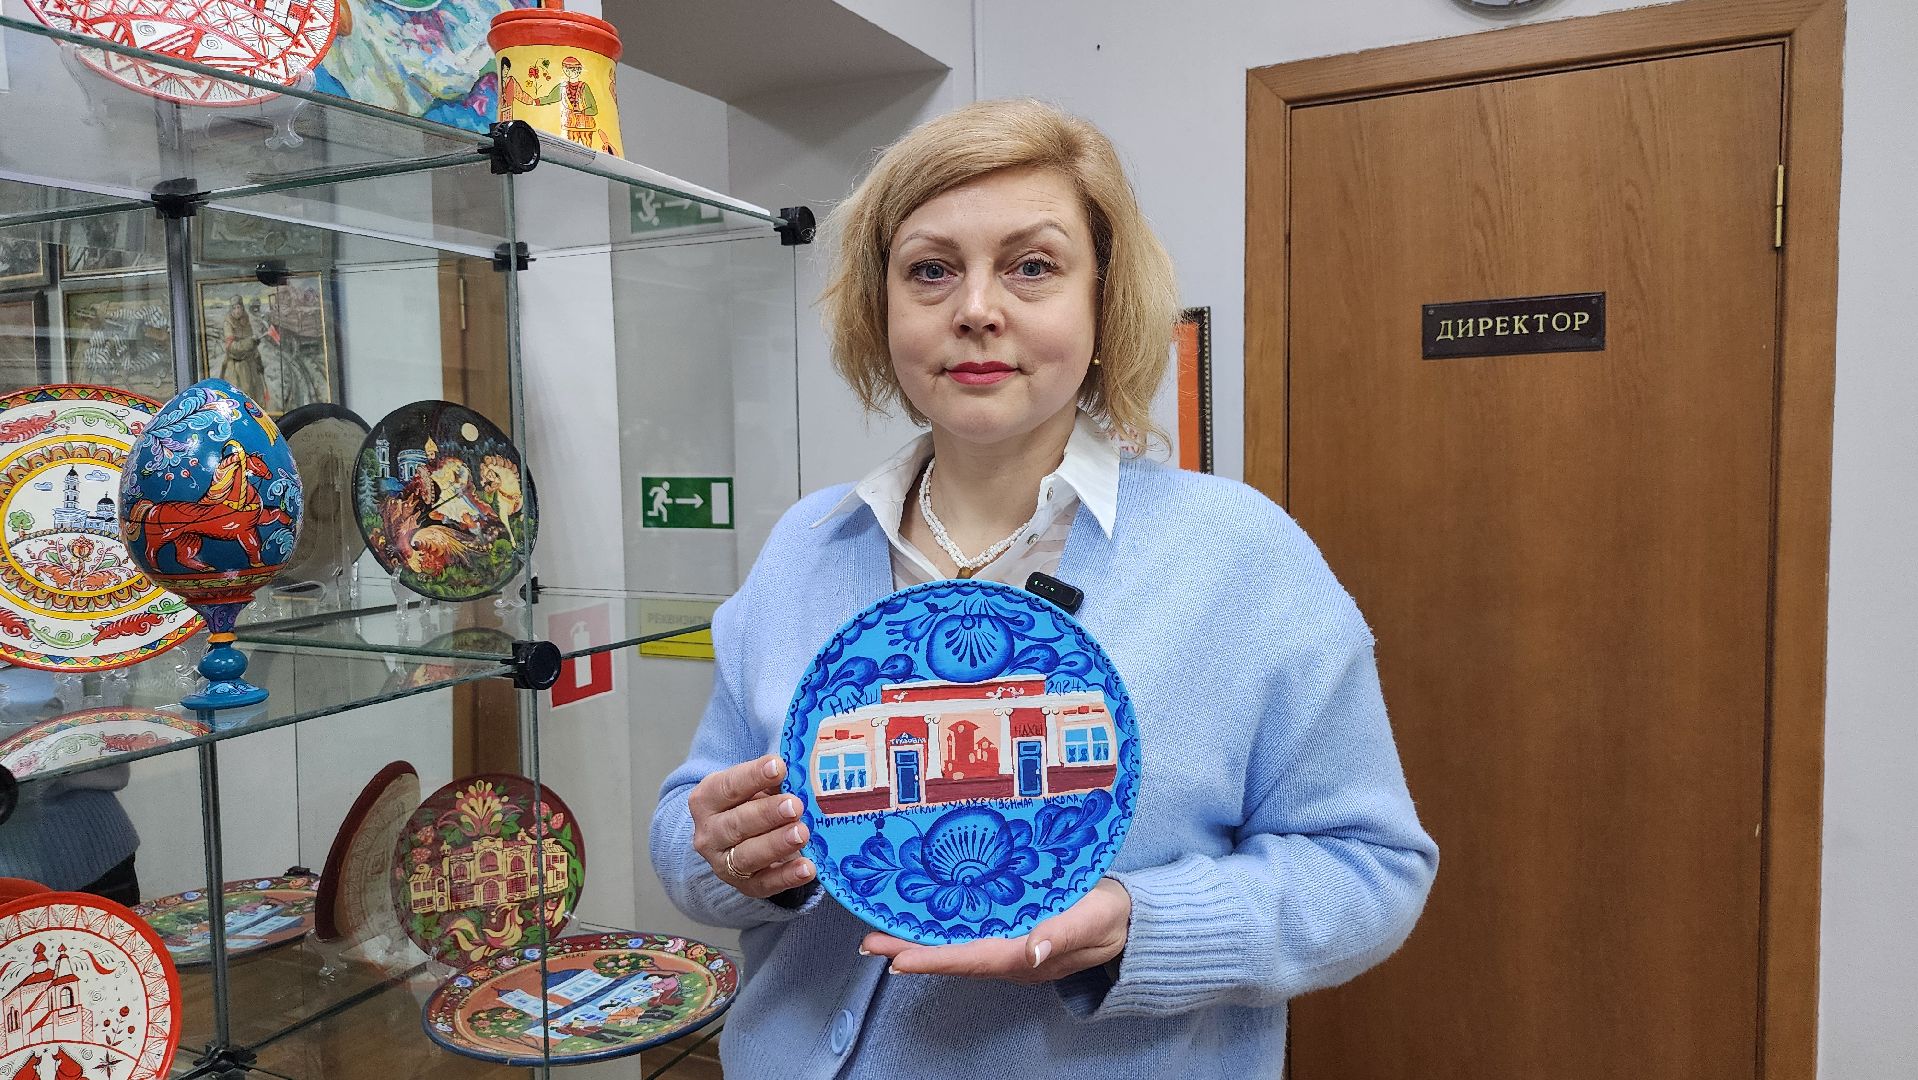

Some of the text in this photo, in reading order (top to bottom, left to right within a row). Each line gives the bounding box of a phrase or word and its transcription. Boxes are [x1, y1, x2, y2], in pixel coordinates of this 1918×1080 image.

[1436, 311, 1590, 342] ДИРЕКТОР
[829, 688, 879, 717] НАХШ
[816, 810, 884, 829] НОГИНСКАЯ
